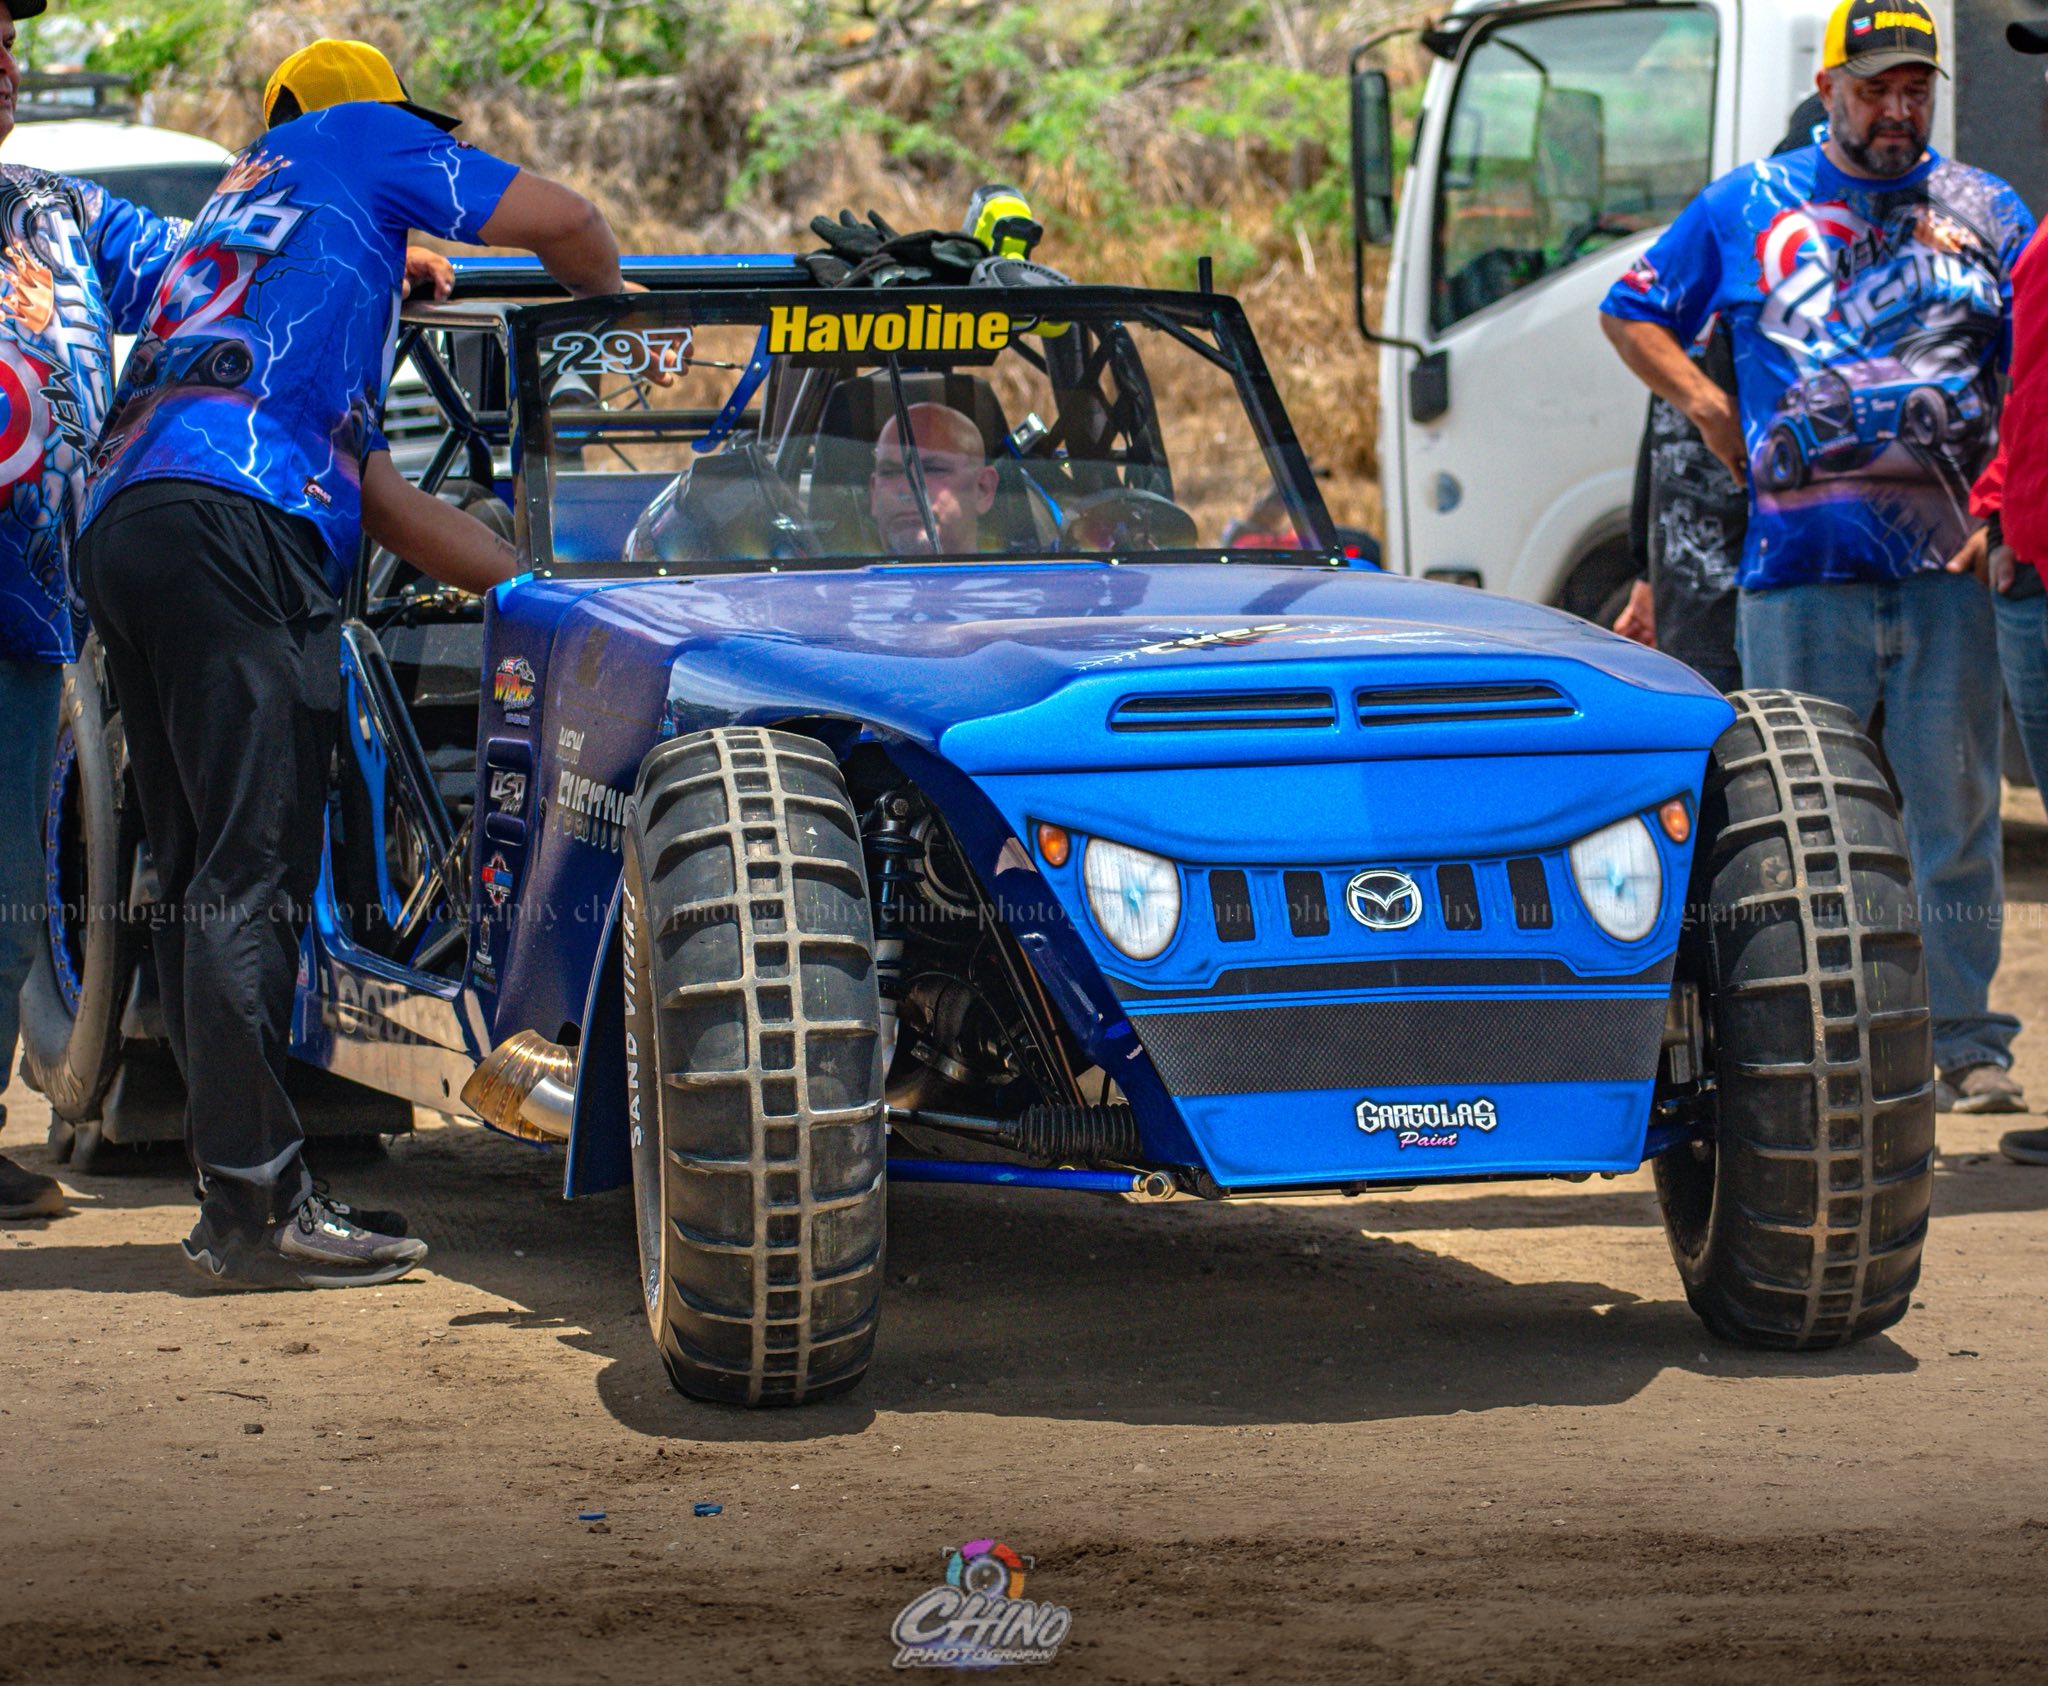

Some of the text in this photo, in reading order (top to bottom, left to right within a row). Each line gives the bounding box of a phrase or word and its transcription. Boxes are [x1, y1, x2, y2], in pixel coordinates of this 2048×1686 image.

[552, 327, 693, 375] 297
[767, 304, 1011, 355] Havoline
[623, 915, 638, 1016] VIPER
[626, 1031, 643, 1149] SAND
[1355, 1099, 1498, 1133] GARGOLAS
[1398, 1131, 1458, 1149] Paint
